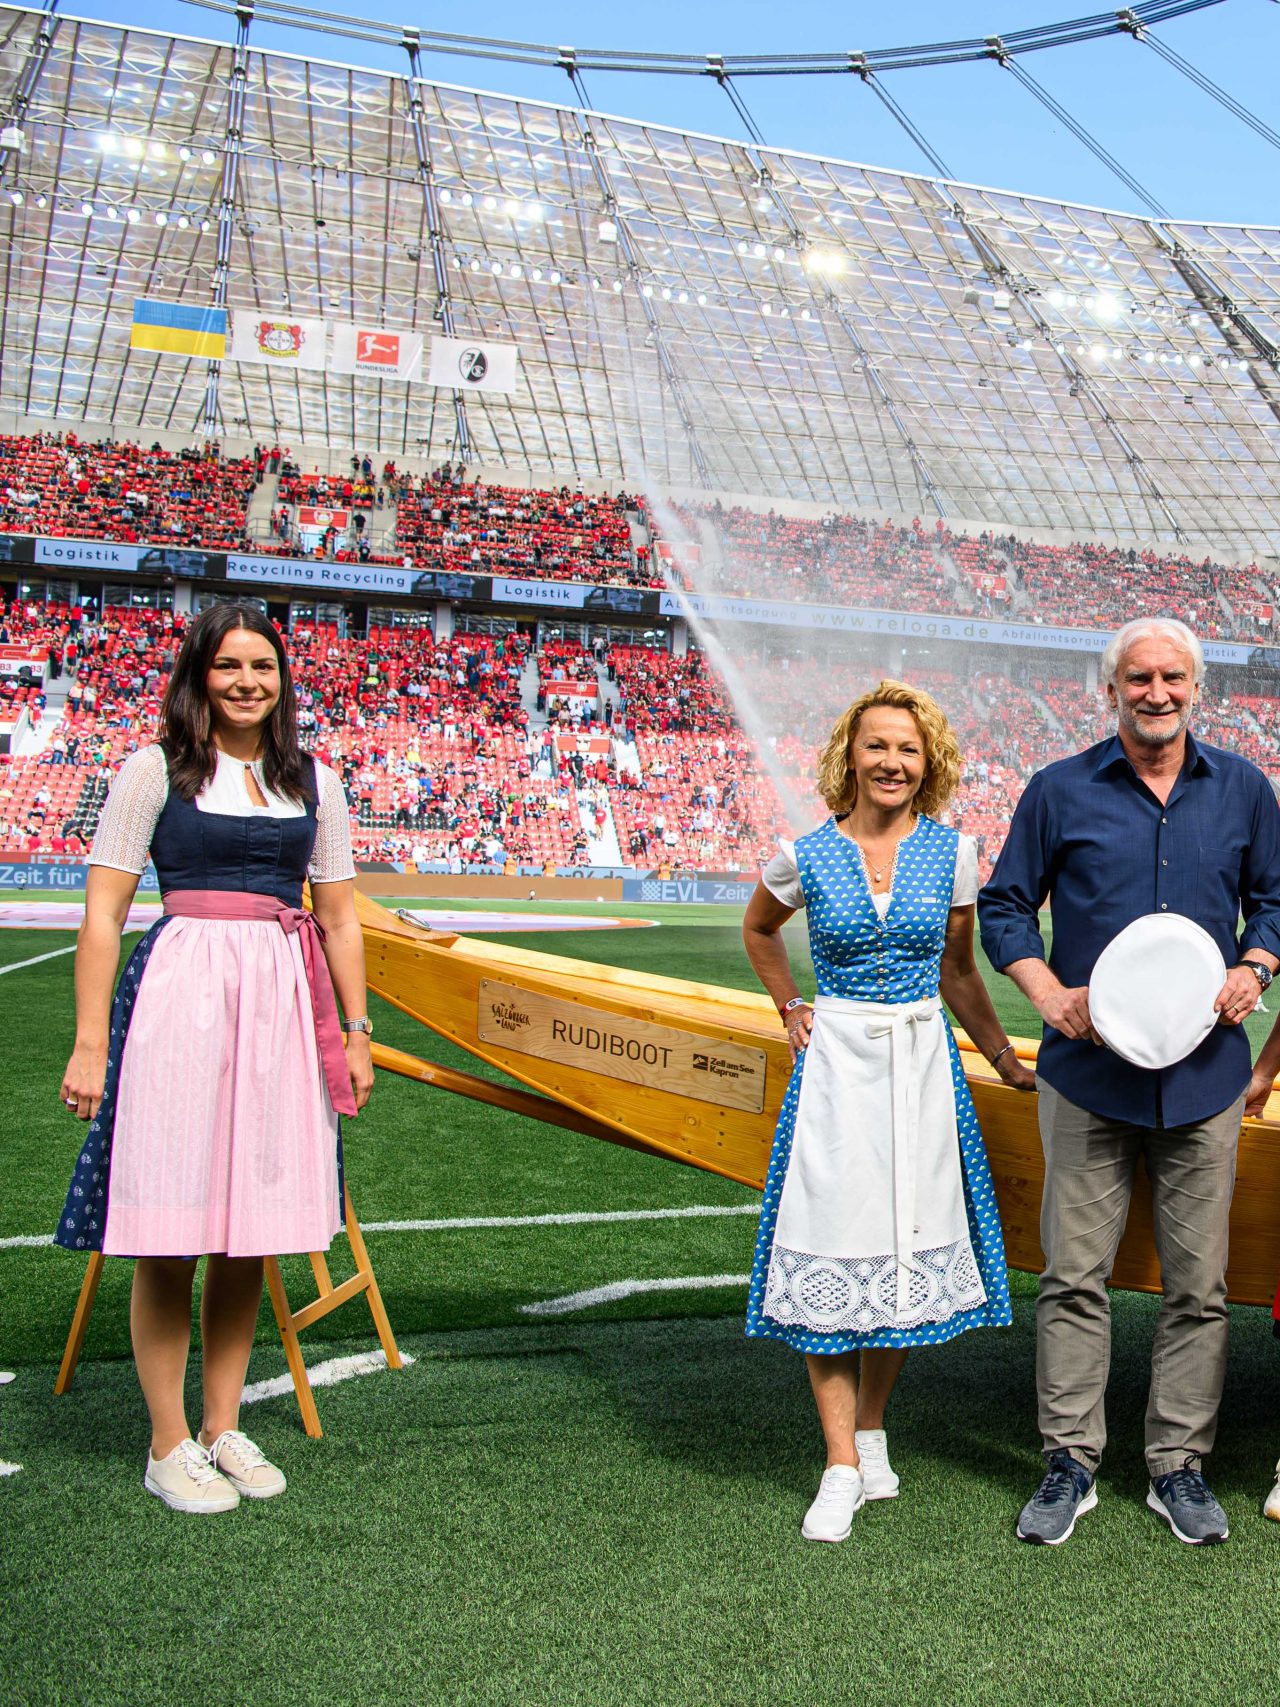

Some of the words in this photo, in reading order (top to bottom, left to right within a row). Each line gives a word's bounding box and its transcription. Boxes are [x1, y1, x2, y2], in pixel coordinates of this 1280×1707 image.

[355, 363, 399, 374] BUNDESLIGA
[42, 545, 120, 562] Logistik
[227, 561, 314, 579] Recycling
[321, 569, 406, 588] Recycling
[504, 584, 571, 599] Logistik
[811, 613, 990, 639] www.reloga.de
[1001, 630, 1108, 648] Abfallentsorgun
[1203, 648, 1238, 659] gistik
[0, 866, 43, 885] Zeit
[48, 867, 82, 886] für
[661, 881, 705, 902] EVL
[713, 884, 749, 900] Zeit
[552, 1019, 673, 1069] RUDIBOOT
[710, 1057, 726, 1067] Zell
[726, 1062, 739, 1071] am
[739, 1064, 755, 1075] See
[710, 1065, 739, 1079] Kaprun
